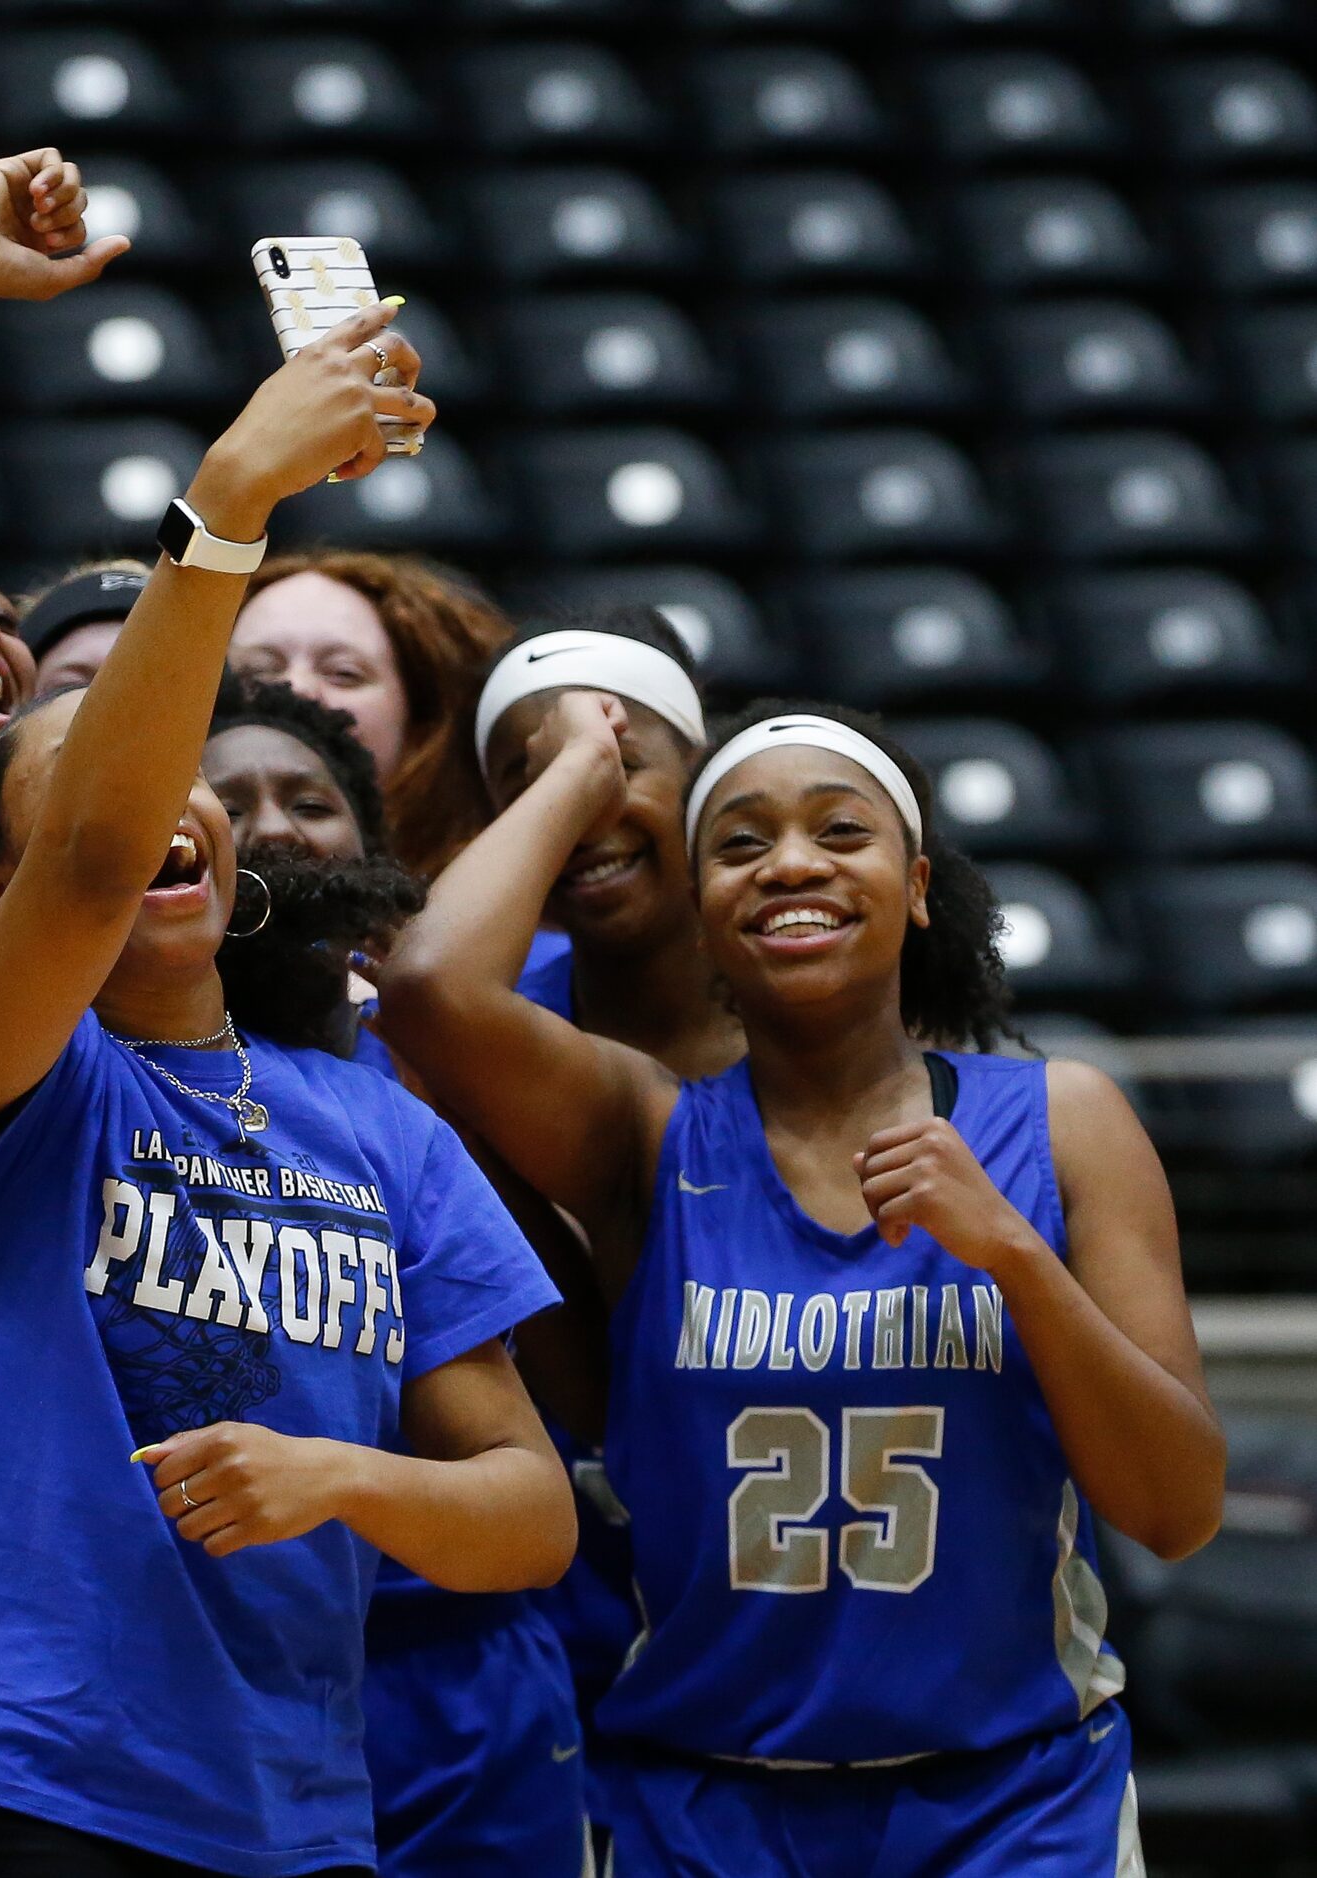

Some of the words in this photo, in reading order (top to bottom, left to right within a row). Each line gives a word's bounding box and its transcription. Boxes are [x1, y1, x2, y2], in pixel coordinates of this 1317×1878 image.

[133, 1129, 173, 1162] LA
[173, 1155, 272, 1198] PANTHER
[280, 1167, 388, 1215] BASKETBAL
[674, 1280, 1004, 1374] MIDLOTHIAN
[726, 1406, 945, 1594] 25
